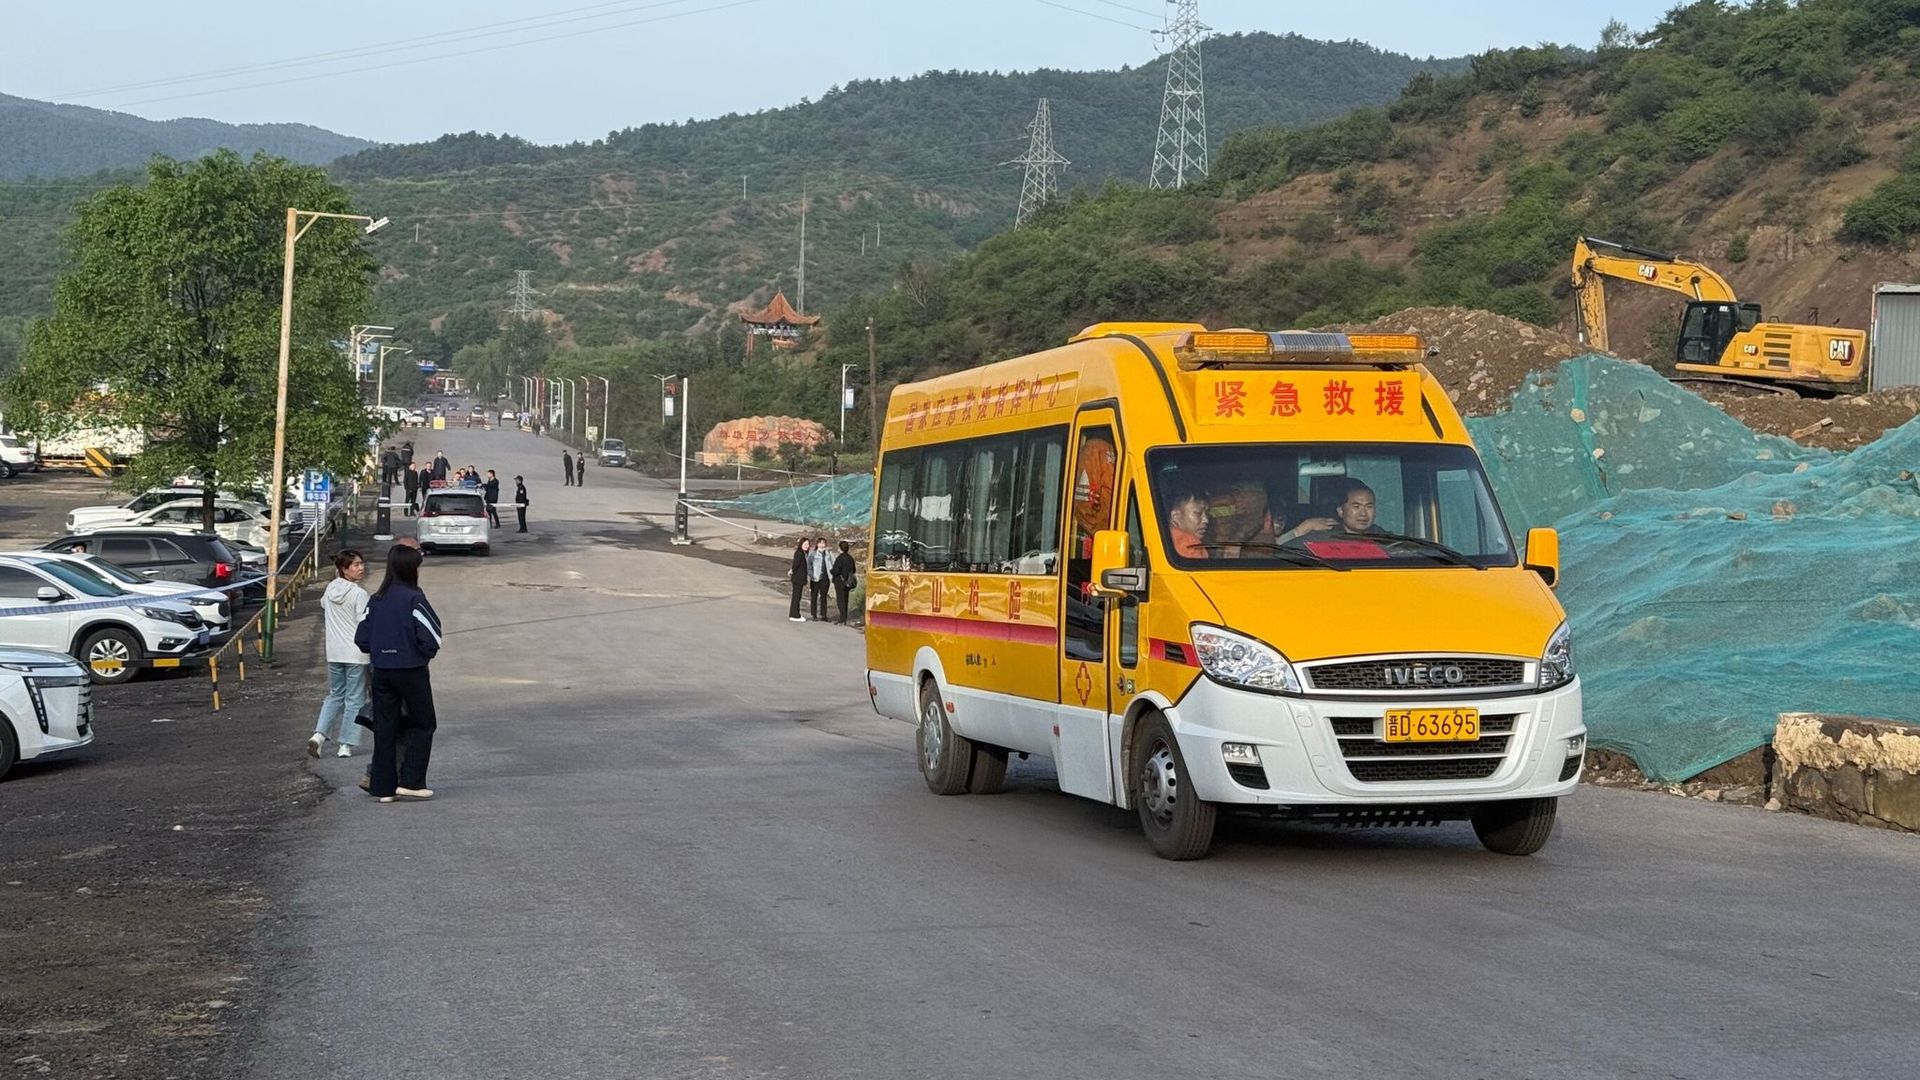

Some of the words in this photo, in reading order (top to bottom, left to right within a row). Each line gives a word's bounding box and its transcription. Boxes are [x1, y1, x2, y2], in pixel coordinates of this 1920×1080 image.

[1639, 264, 1656, 278] CAT
[1744, 345, 1756, 354] CAT
[1829, 340, 1851, 360] CAT
[1214, 378, 1405, 418] 紧急救援
[1384, 666, 1463, 685] IVECO
